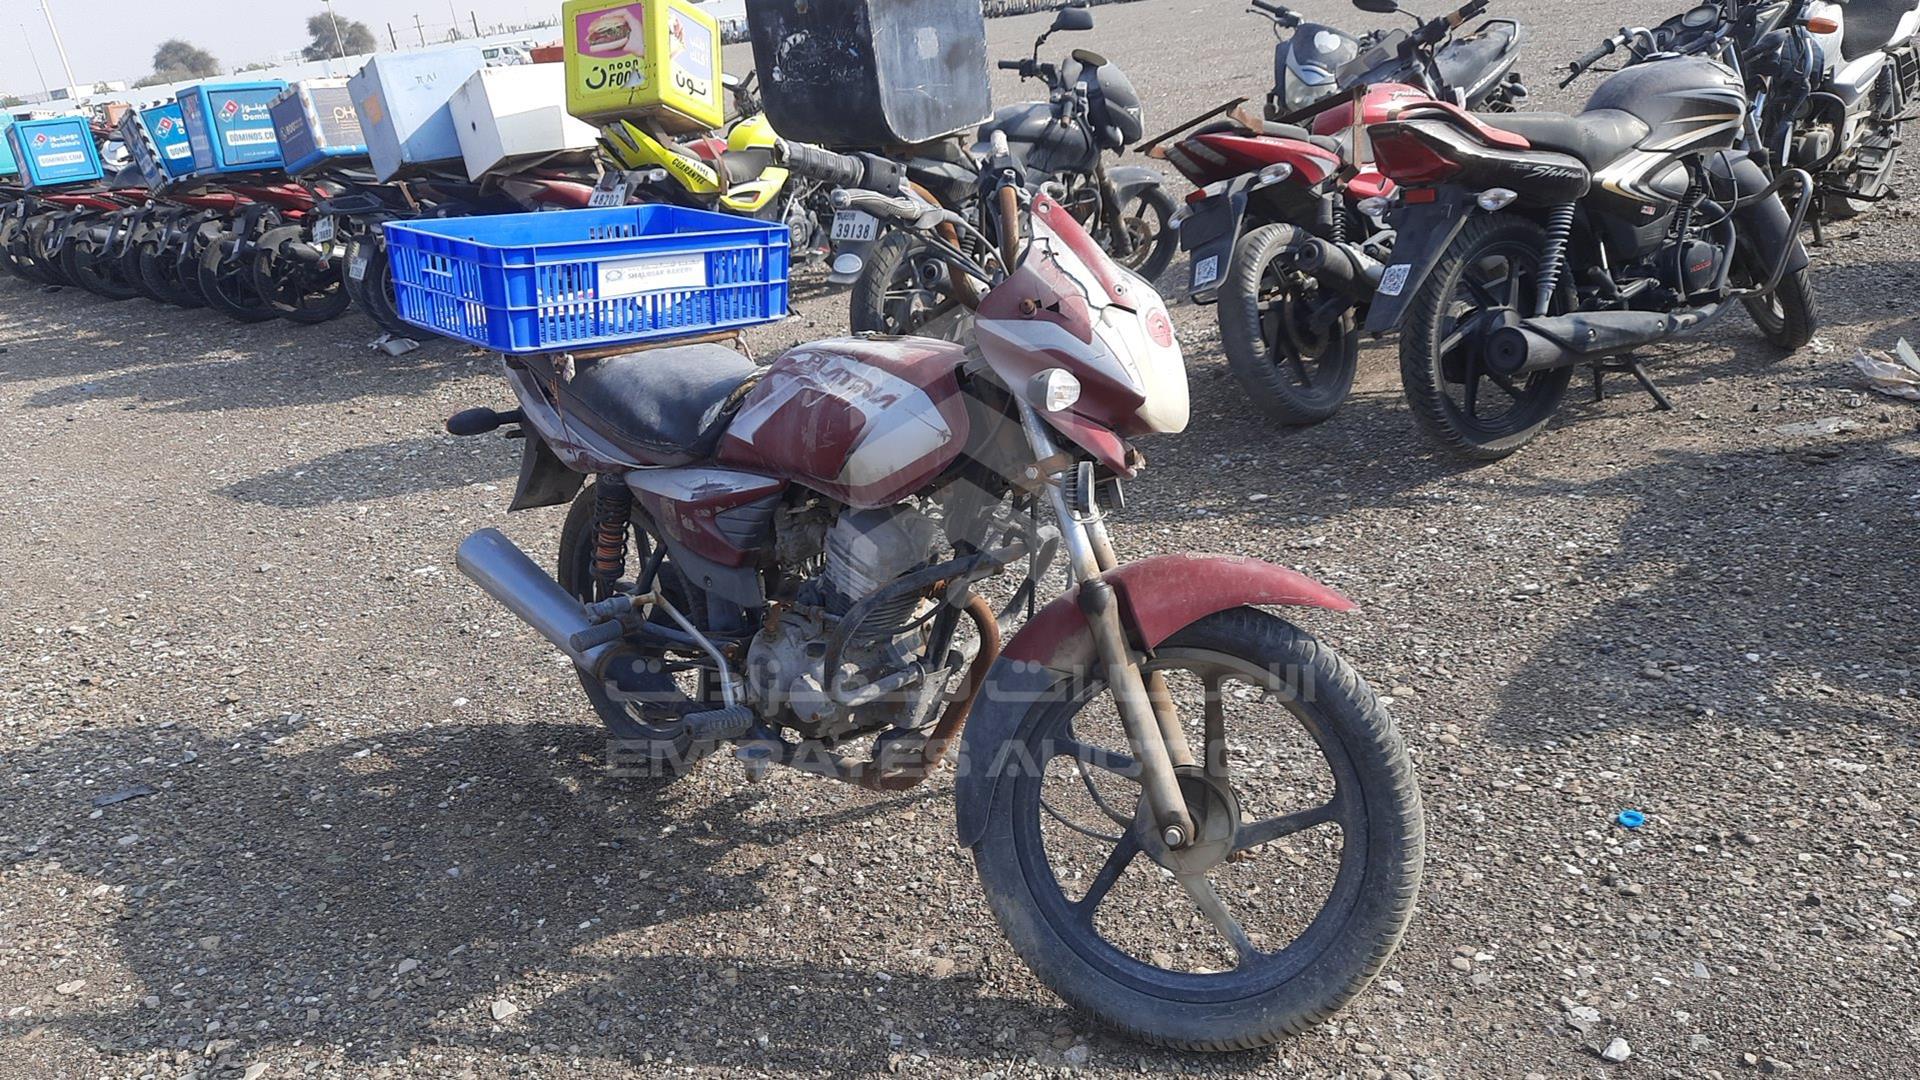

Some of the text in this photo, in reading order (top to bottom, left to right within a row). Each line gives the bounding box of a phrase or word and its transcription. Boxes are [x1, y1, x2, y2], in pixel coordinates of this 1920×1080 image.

[608, 59, 639, 71] noon
[242, 112, 270, 121] Domin
[229, 130, 275, 143] DOMINOS.CO
[836, 223, 870, 240] 39138
